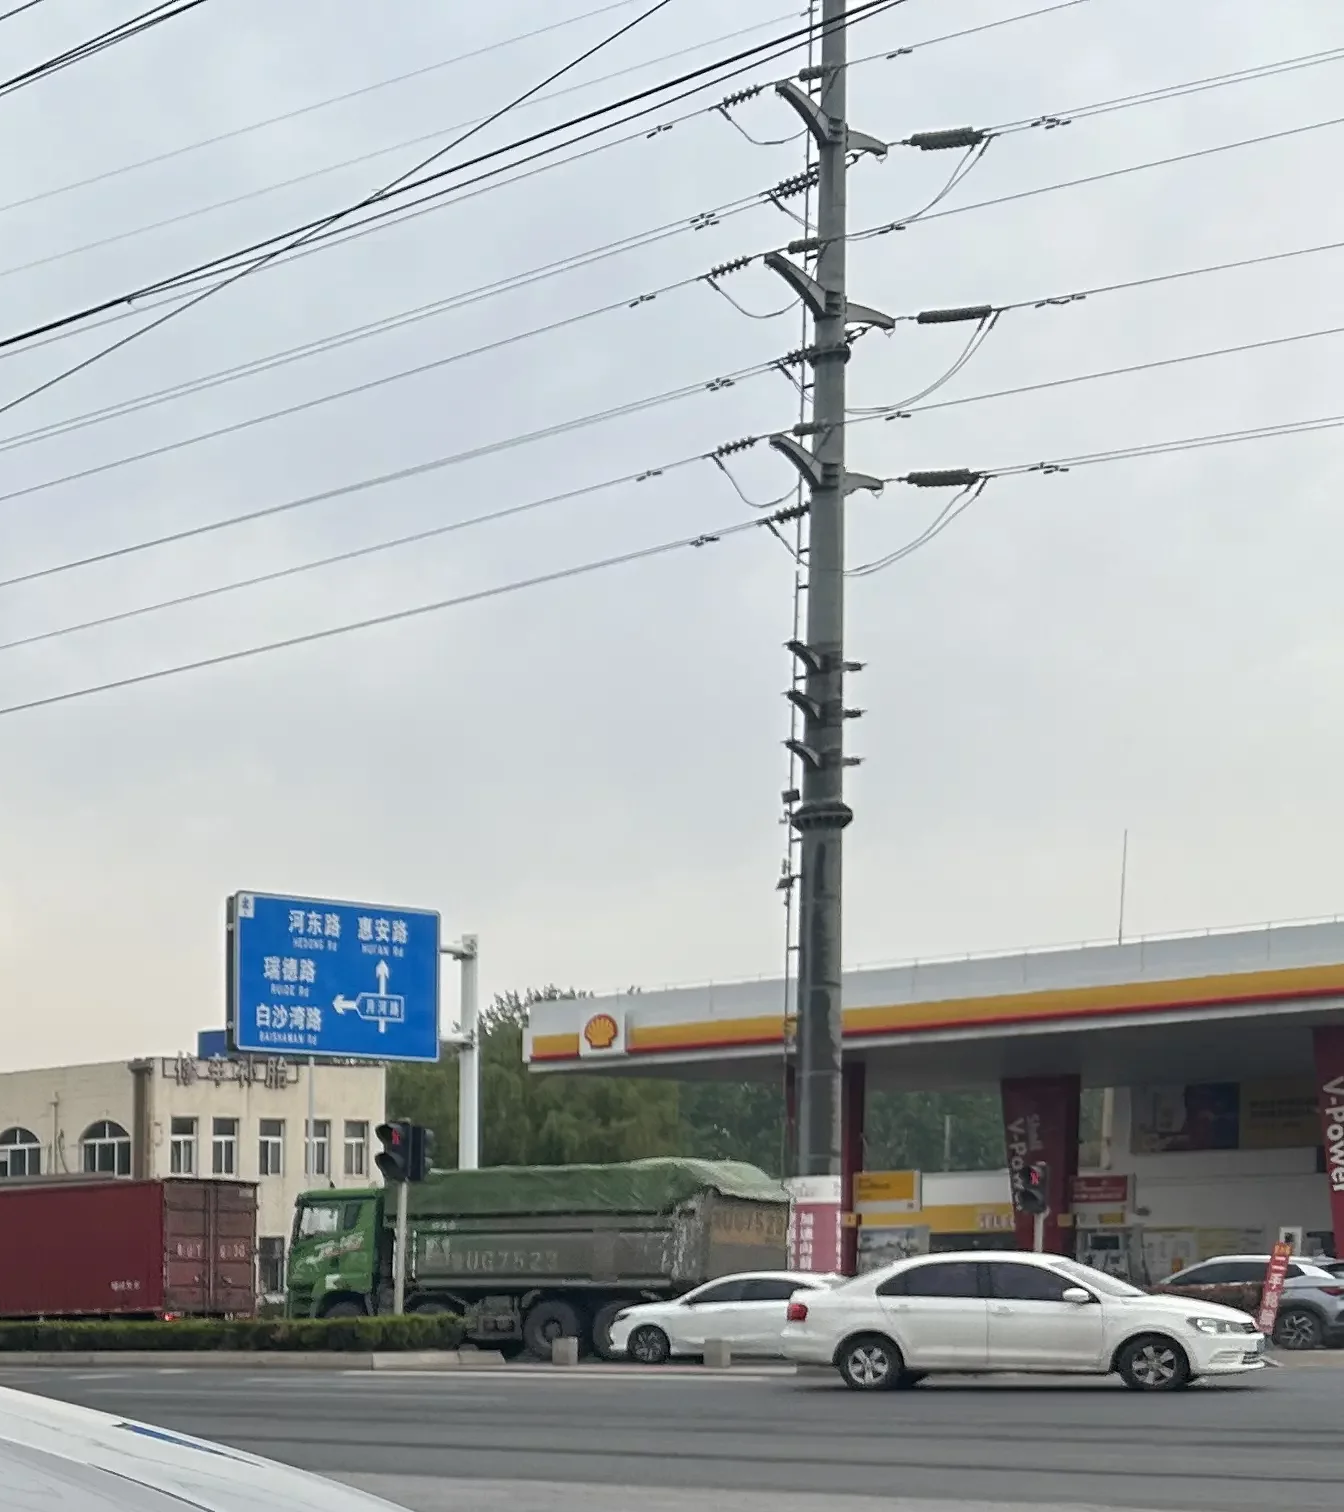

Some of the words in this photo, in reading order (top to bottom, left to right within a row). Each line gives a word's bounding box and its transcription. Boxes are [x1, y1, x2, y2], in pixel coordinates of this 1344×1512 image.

[288, 909, 341, 938] 河东路
[357, 916, 409, 945] 惠安路
[255, 1002, 322, 1033] 白沙湾路
